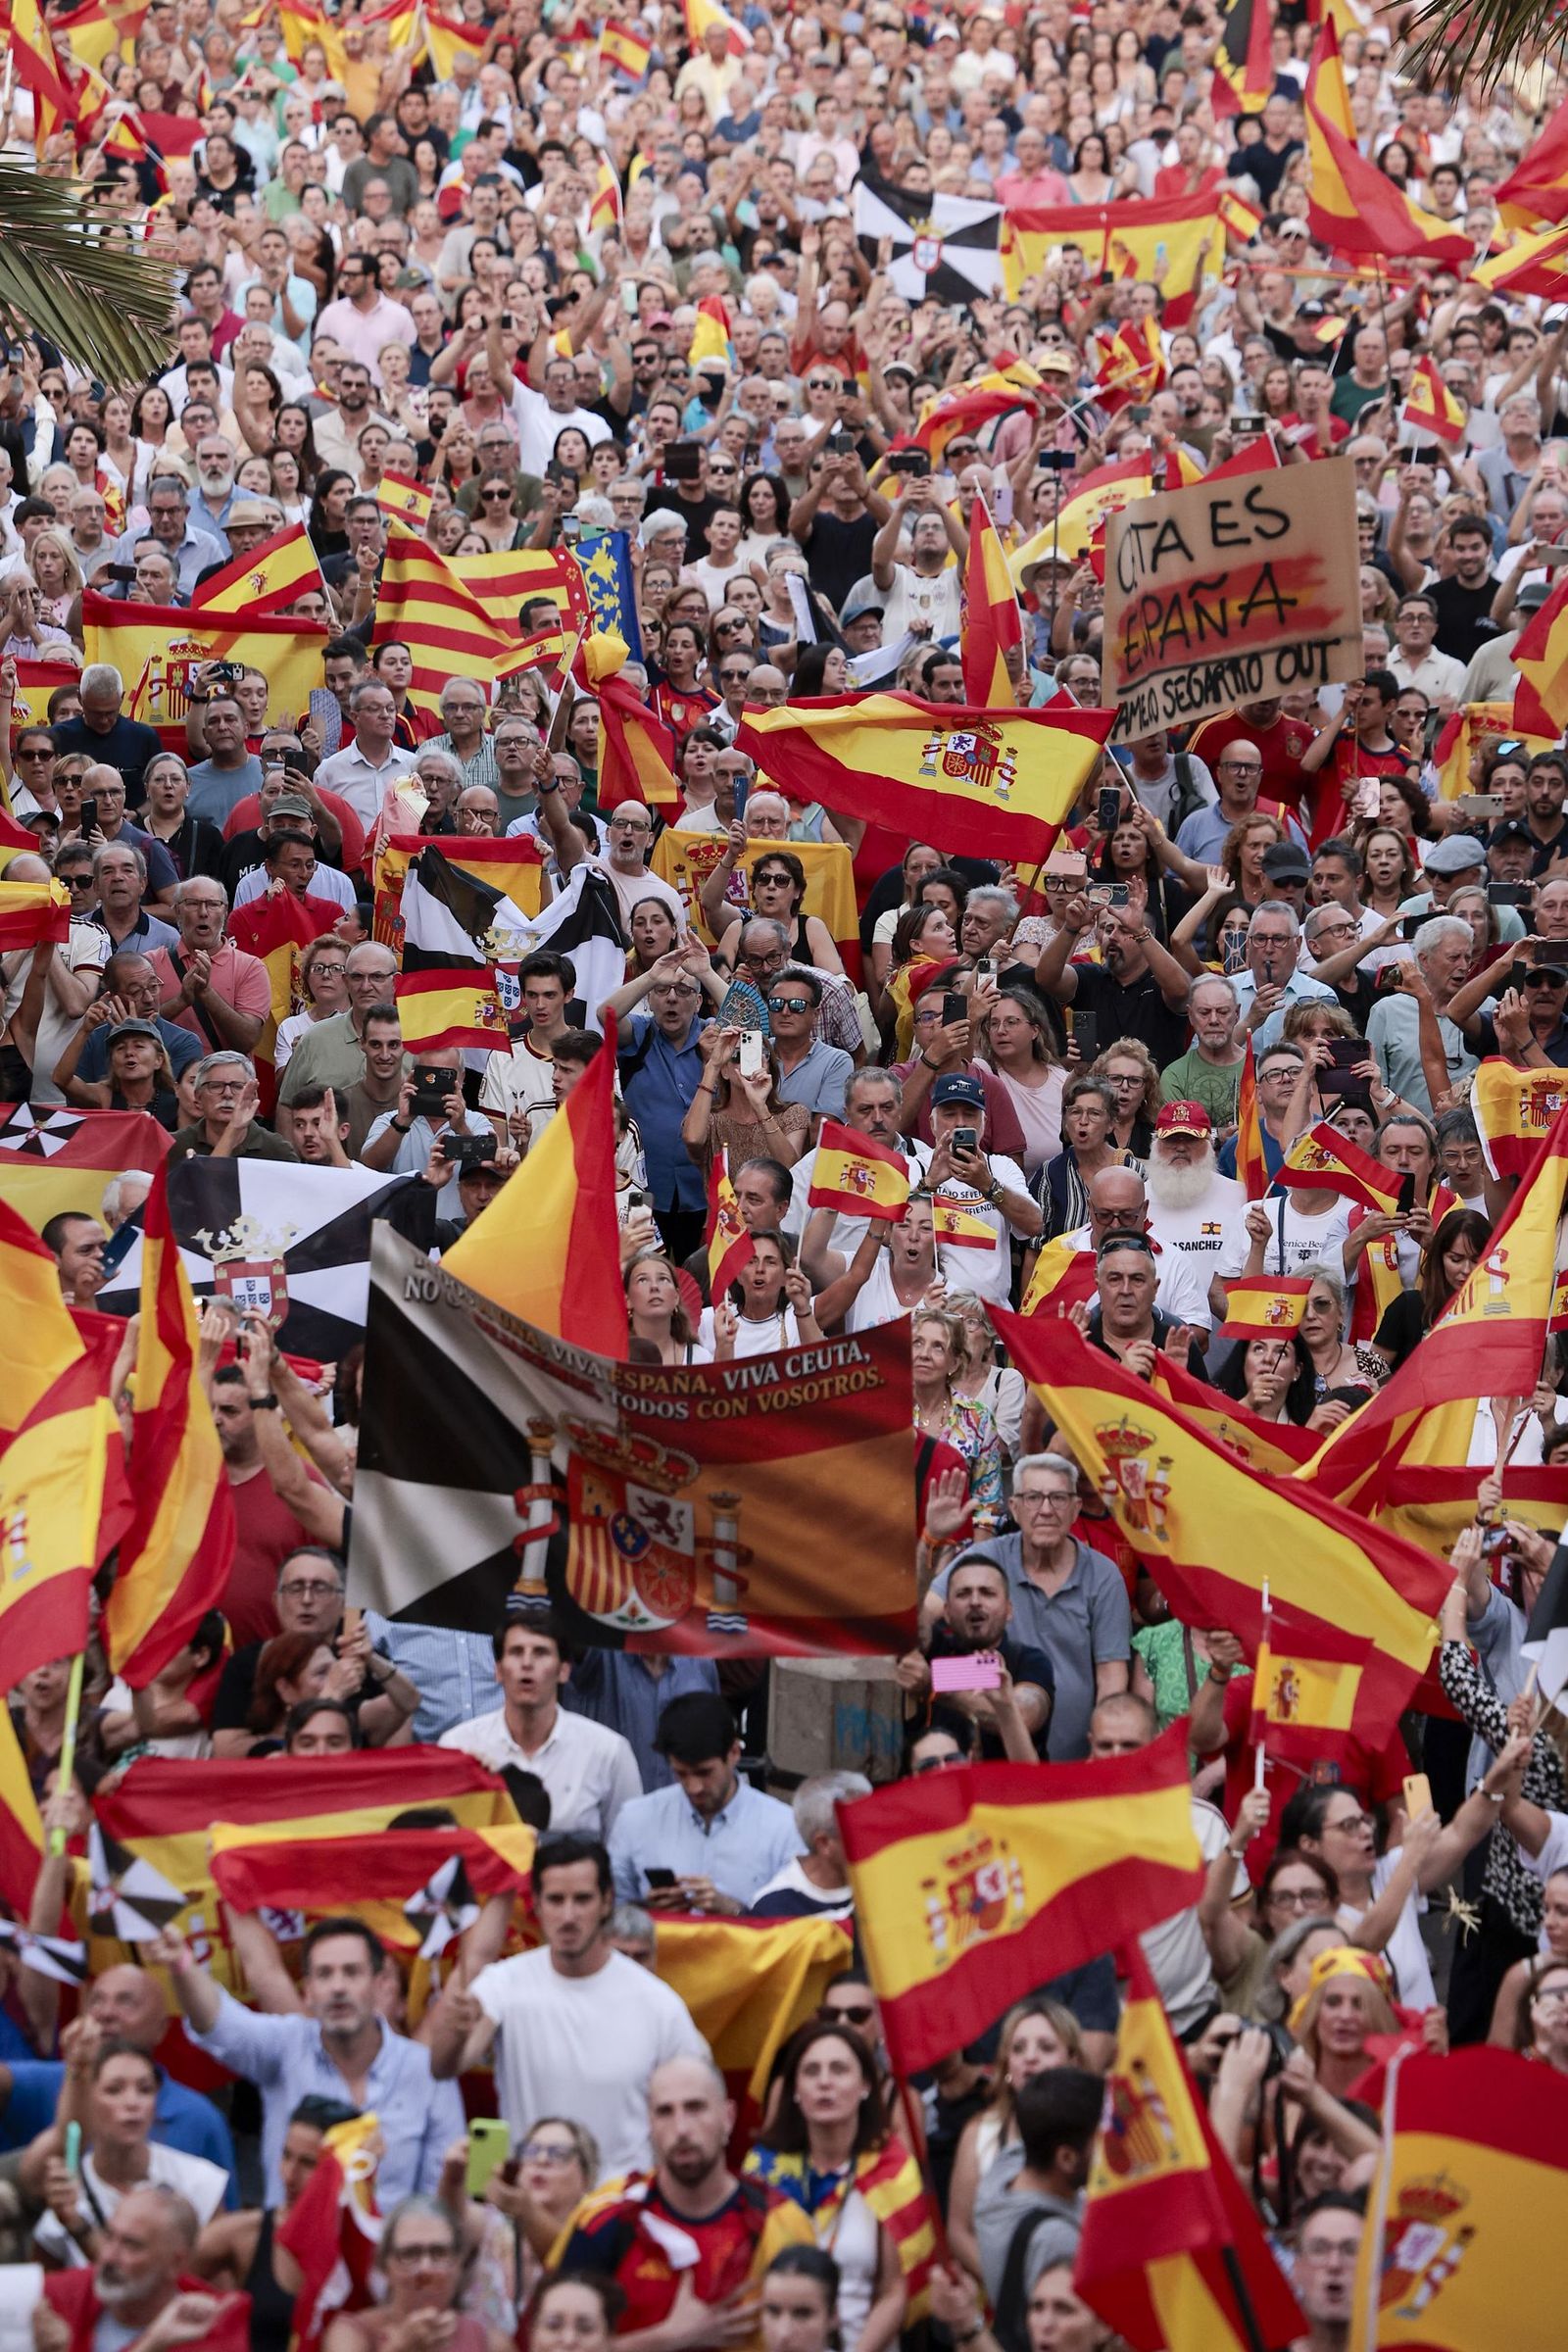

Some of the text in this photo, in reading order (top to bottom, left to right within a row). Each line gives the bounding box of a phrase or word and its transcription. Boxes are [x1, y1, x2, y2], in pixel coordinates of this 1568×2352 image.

[1209, 485, 1291, 548] ES
[1276, 638, 1341, 685] OUT
[1281, 1239, 1307, 1248] enice
[404, 1276, 440, 1302] NO
[611, 1390, 689, 1420] TODOS
[697, 1396, 750, 1419] CON
[757, 1366, 884, 1411] VOSOTROS.
[551, 1342, 605, 1378] VIVA
[611, 1370, 716, 1396] ESPAÑA,
[723, 1363, 779, 1392] VIVA
[786, 1340, 870, 1379] CEUTA,
